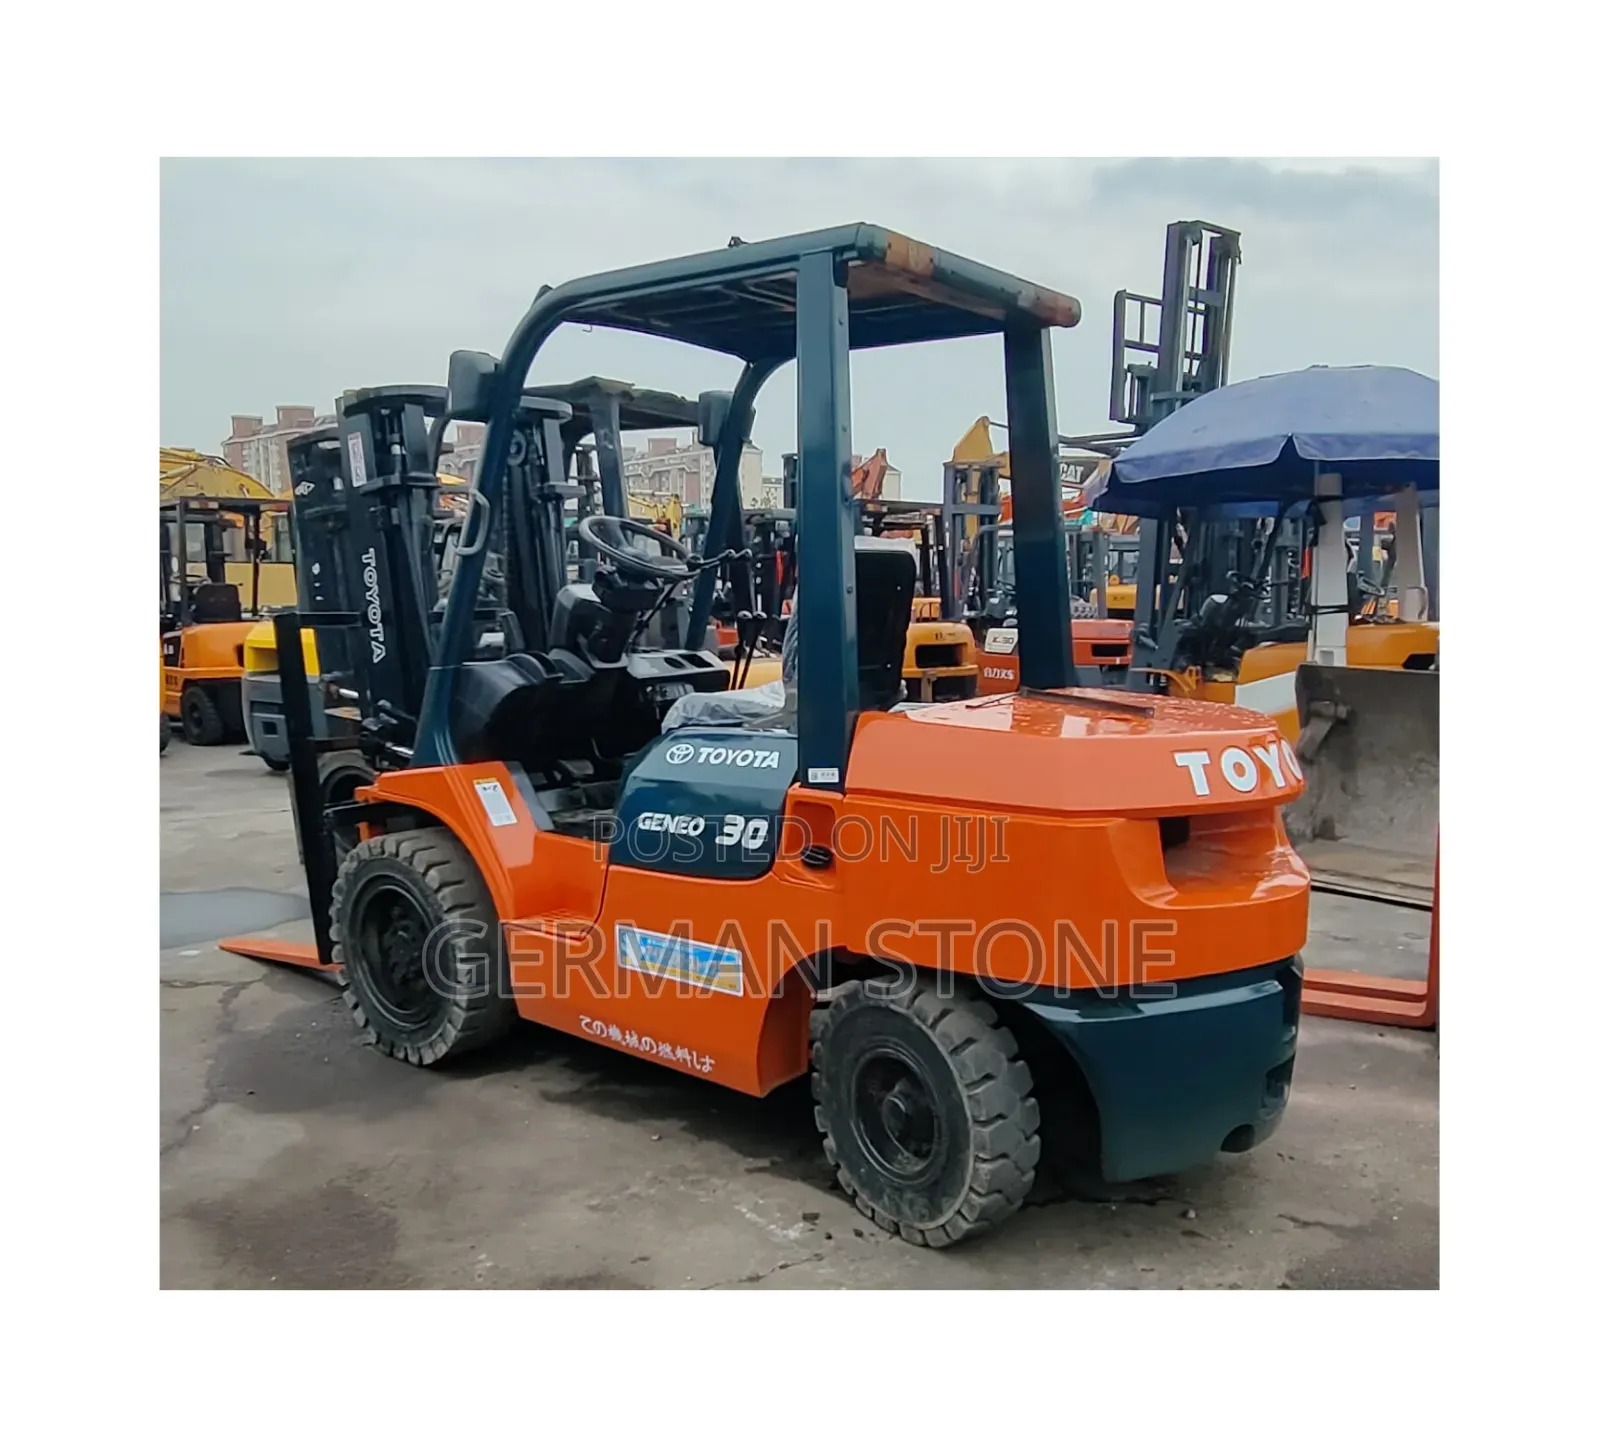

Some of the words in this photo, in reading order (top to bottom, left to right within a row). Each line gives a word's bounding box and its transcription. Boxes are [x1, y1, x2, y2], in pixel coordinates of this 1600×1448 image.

[1060, 463, 1084, 483] CAT
[362, 548, 386, 663] TOYOTA
[697, 747, 780, 769] TOYOTA
[638, 812, 705, 837] GENEO
[715, 814, 769, 850] 30
